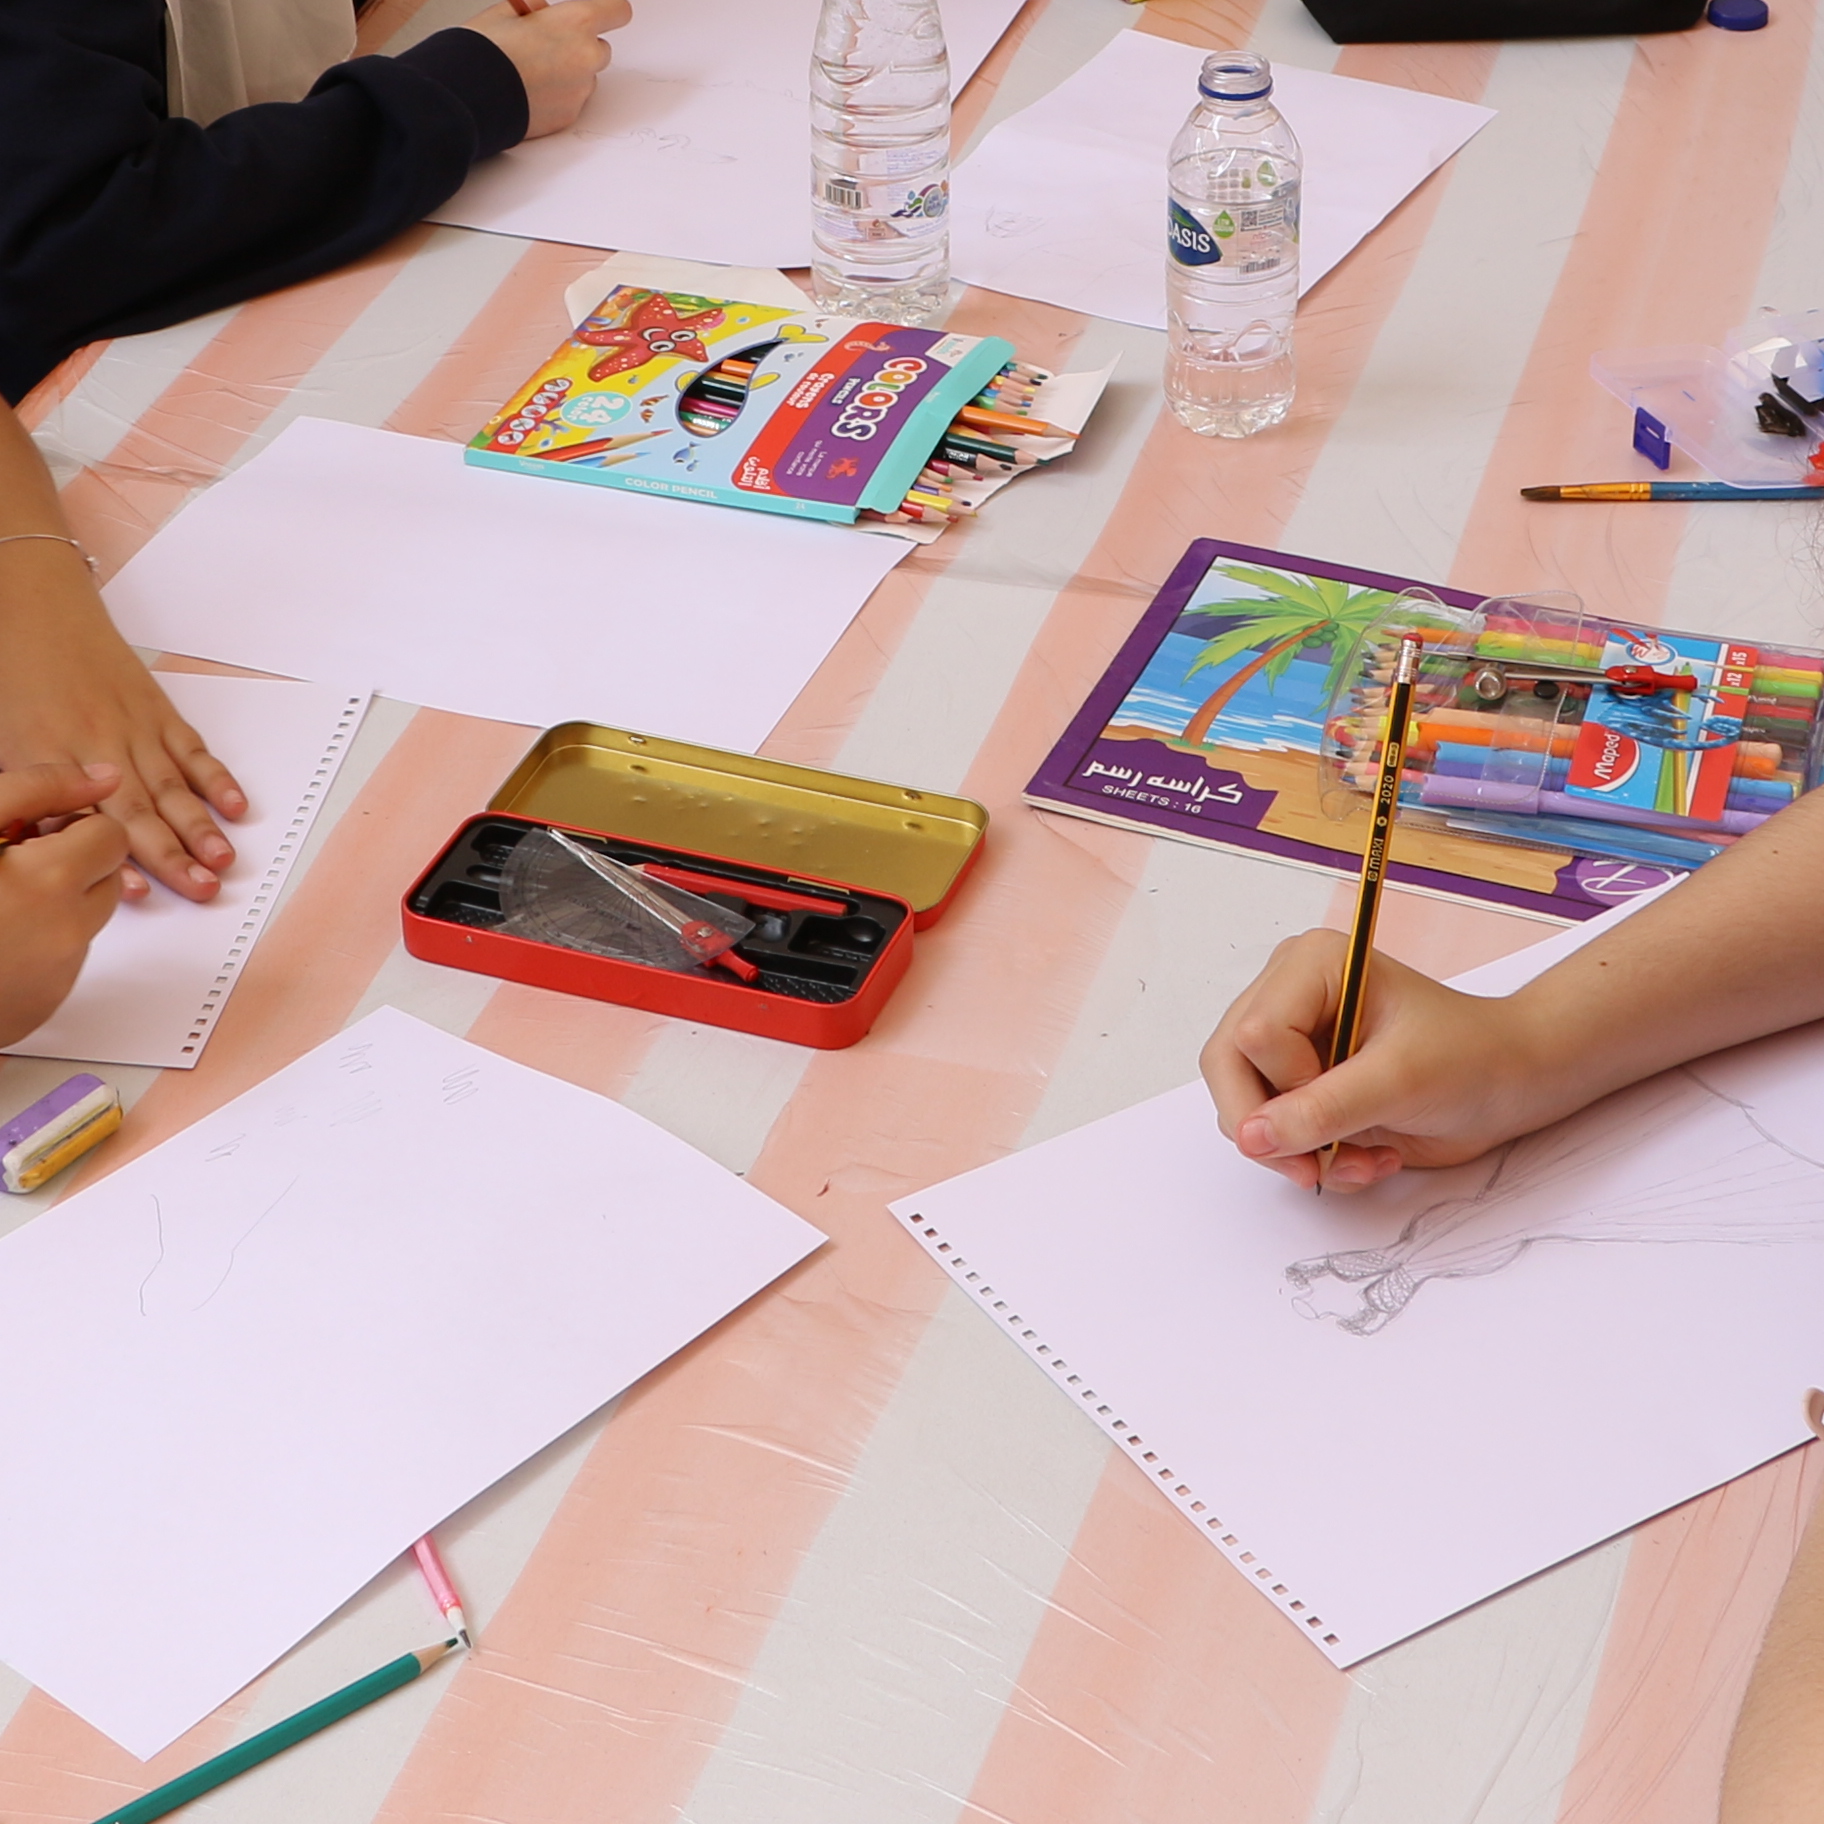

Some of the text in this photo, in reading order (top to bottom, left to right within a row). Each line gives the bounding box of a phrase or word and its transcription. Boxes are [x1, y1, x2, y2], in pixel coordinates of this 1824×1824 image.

[796, 373, 835, 409] Crayons
[831, 357, 927, 440] COLORS
[581, 396, 625, 424] 24
[625, 477, 718, 499] COLOR PENCIL
[1732, 651, 1747, 666] x15
[1726, 672, 1743, 687] x12
[1594, 731, 1621, 780] Maped
[1082, 760, 1143, 787] رسم
[1102, 785, 1171, 806] SHEETS
[1184, 803, 1202, 814] 16
[1381, 775, 1394, 805] 2020
